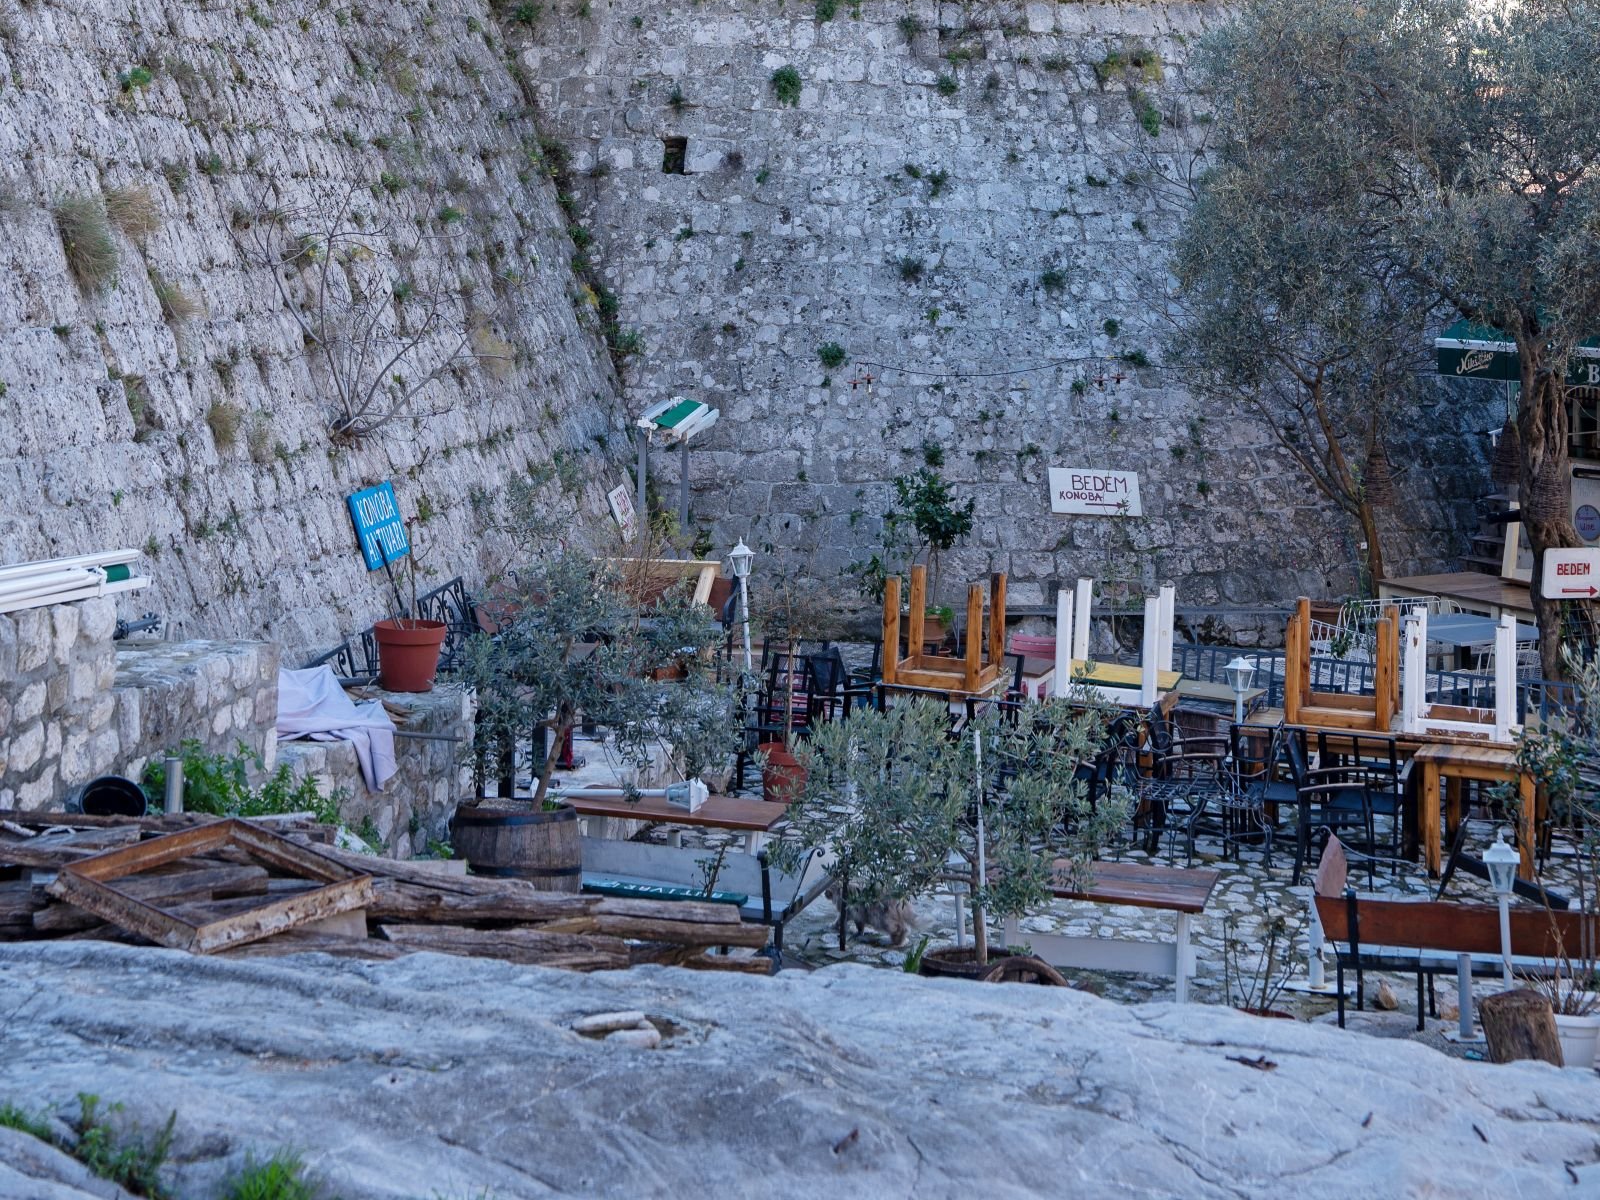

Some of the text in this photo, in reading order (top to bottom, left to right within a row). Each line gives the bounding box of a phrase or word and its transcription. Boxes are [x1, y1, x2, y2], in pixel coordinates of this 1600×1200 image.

[1071, 474, 1128, 494] BEDEM
[1059, 491, 1103, 502] KONOBA
[356, 490, 396, 528] KONOBA
[366, 521, 407, 562] ANTIVARI
[1557, 563, 1590, 575] BEDEM
